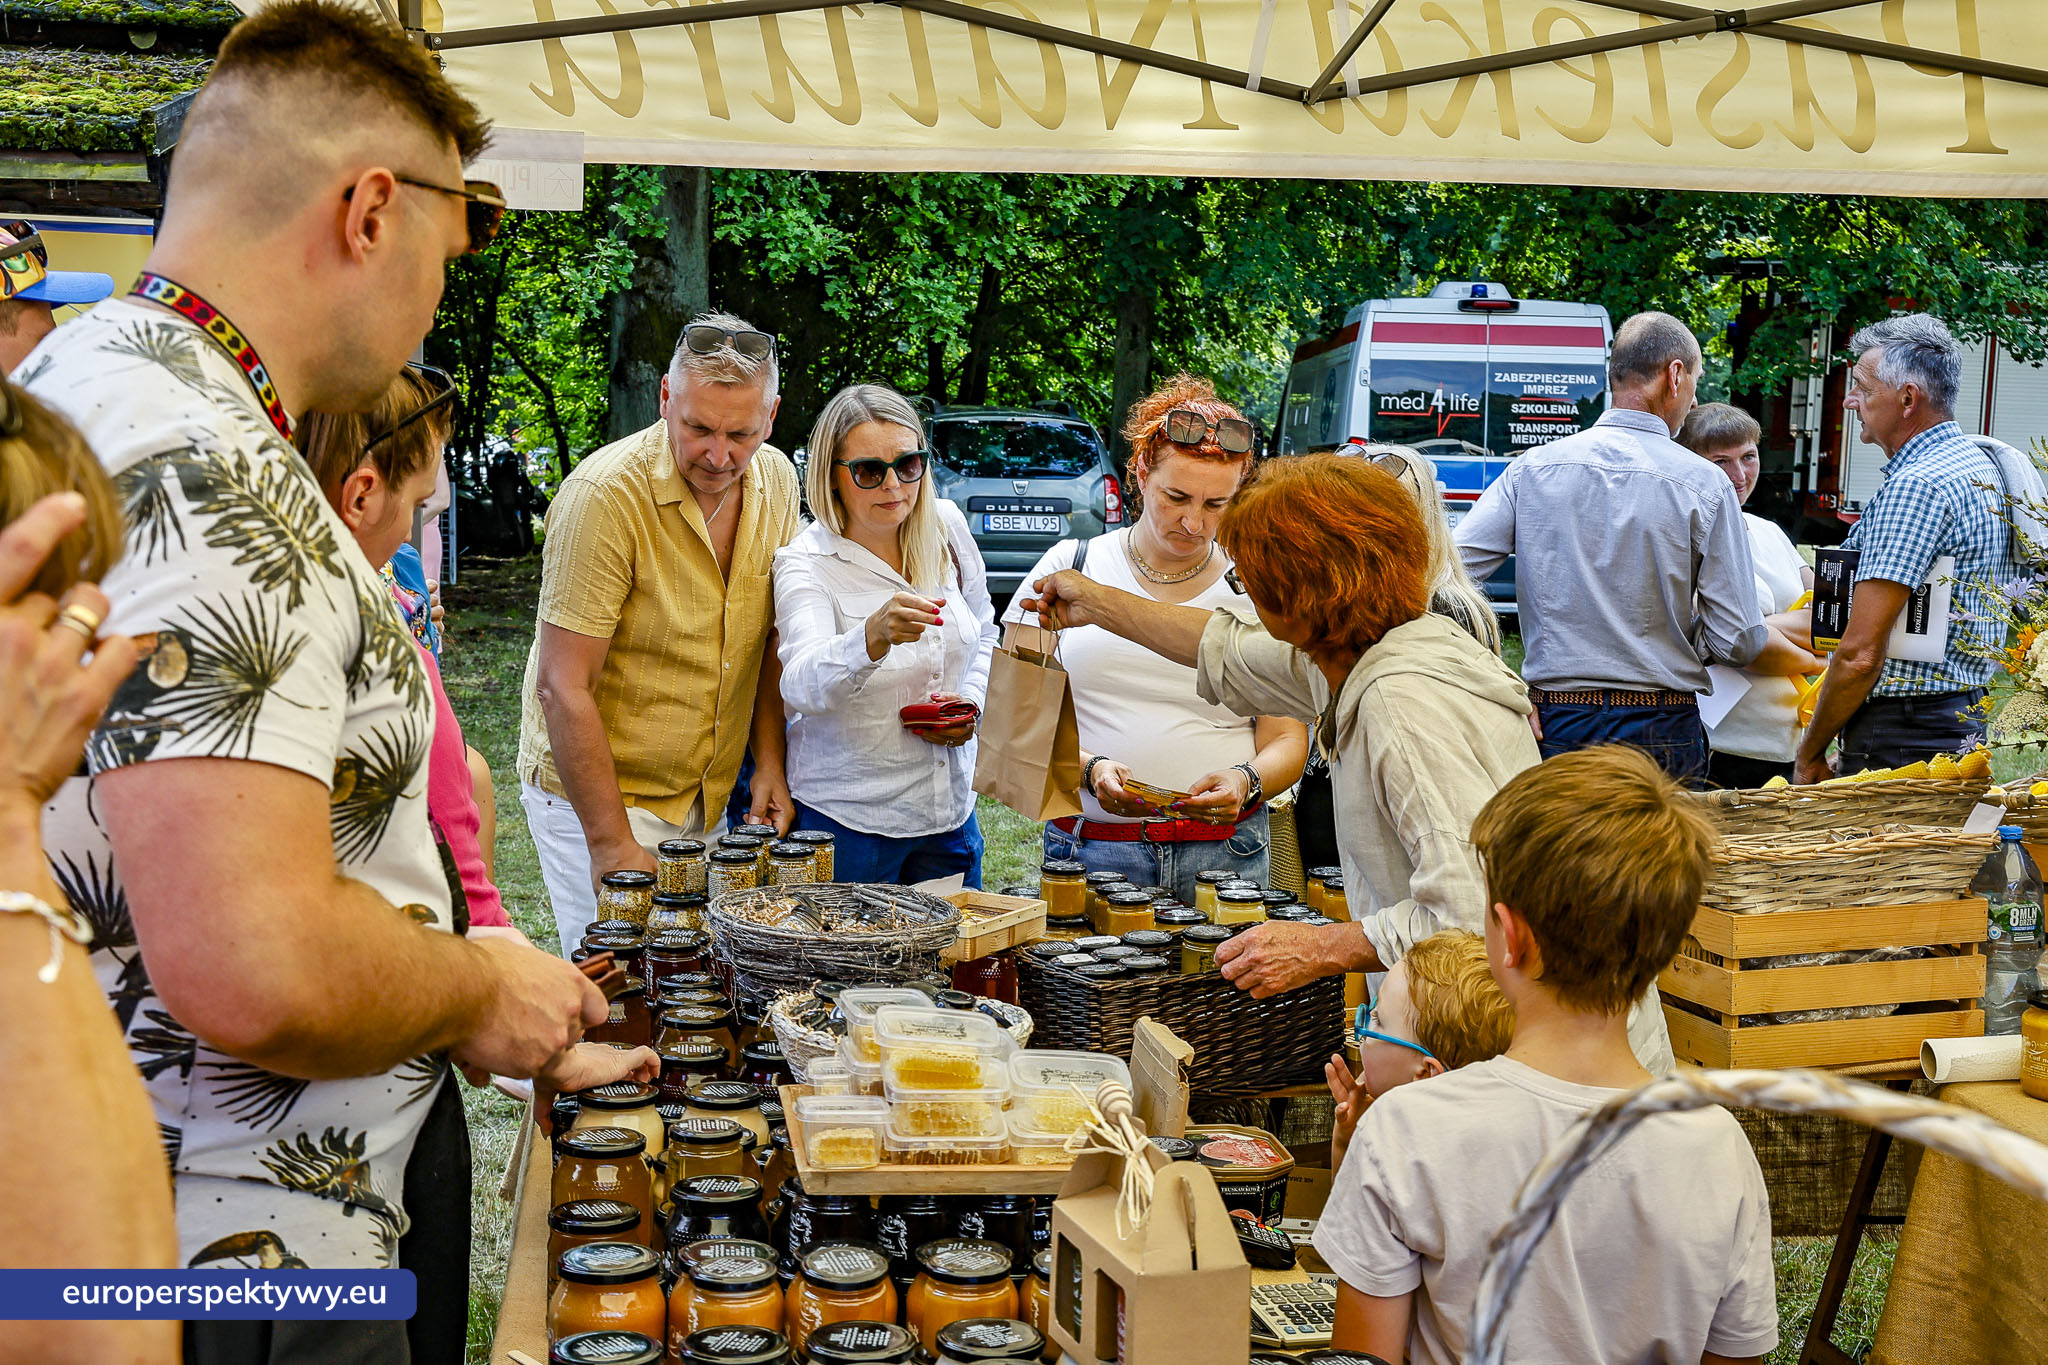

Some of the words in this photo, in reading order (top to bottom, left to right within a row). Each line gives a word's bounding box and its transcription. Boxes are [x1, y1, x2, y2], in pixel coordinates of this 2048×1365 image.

[1494, 372, 1598, 385] ZABEZPIECZENIA
[1523, 384, 1569, 396] IMPREZ
[1380, 393, 1424, 411] med
[1431, 388, 1445, 413] 4
[1450, 392, 1480, 411] life
[1511, 403, 1580, 416] SZKOLENIA
[1508, 422, 1581, 435] TRANSPORT
[985, 504, 1055, 513] DUSTER
[992, 515, 1021, 530] SBE
[1025, 516, 1058, 531] VL95
[1914, 596, 1923, 634] TECHTRON
[2010, 908, 2020, 927] 8
[2020, 907, 2038, 920] MLN
